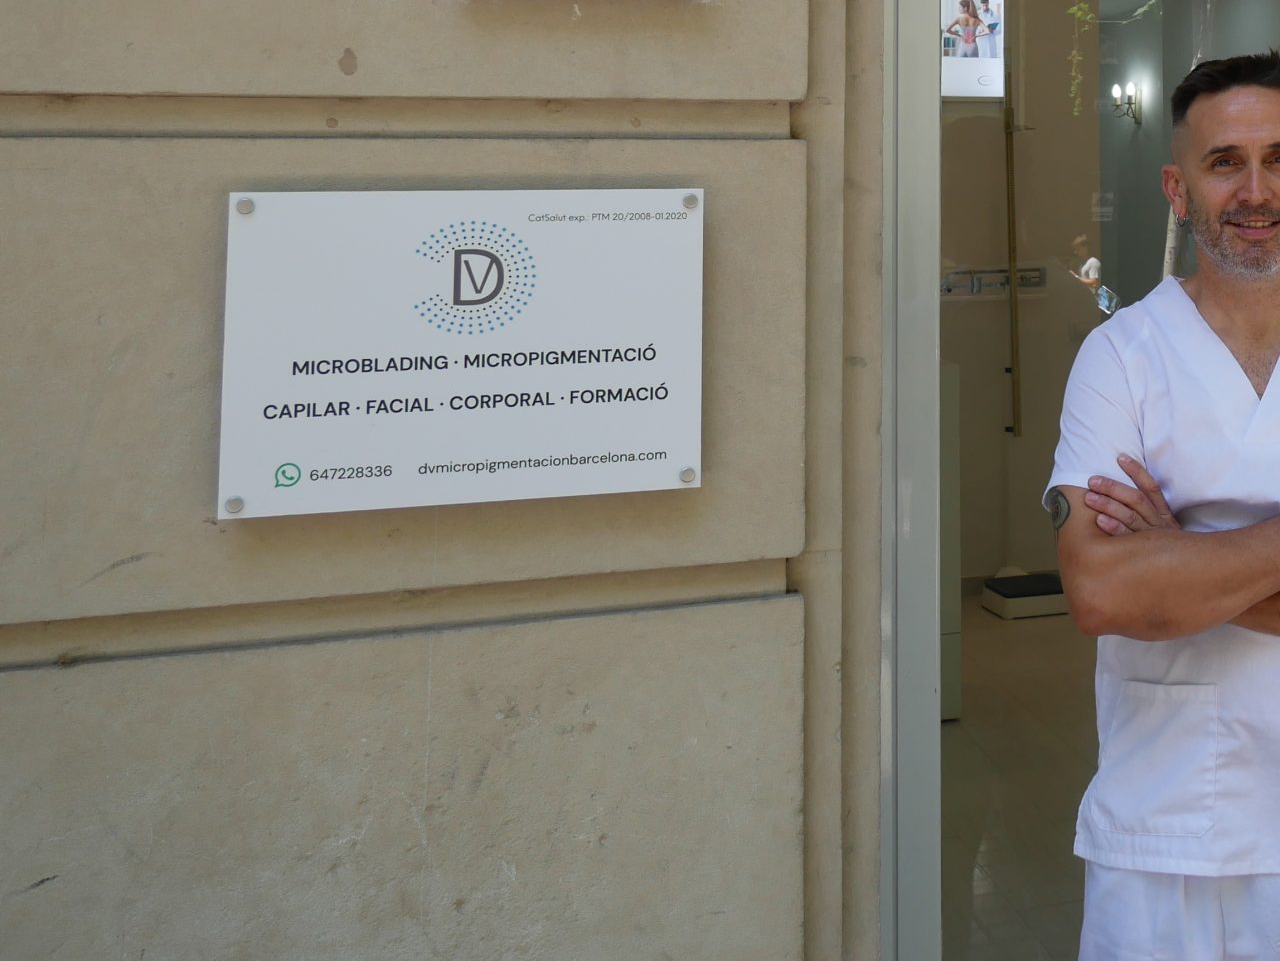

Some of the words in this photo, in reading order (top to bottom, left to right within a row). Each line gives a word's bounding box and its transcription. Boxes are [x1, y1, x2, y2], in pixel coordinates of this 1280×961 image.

[527, 213, 566, 223] CatSalut
[591, 212, 610, 221] PTM
[292, 355, 449, 376] MICROBLADING
[464, 343, 656, 369] MICROPIGMENTACIÓ
[263, 401, 350, 420] CAPILAR
[366, 397, 434, 415] FACIAL
[449, 391, 555, 410] CORPORAL
[569, 382, 669, 405] FORMACIÓ
[309, 465, 393, 481] 647228336
[418, 450, 667, 475] dvmicropigmentacionbarcelona.com
